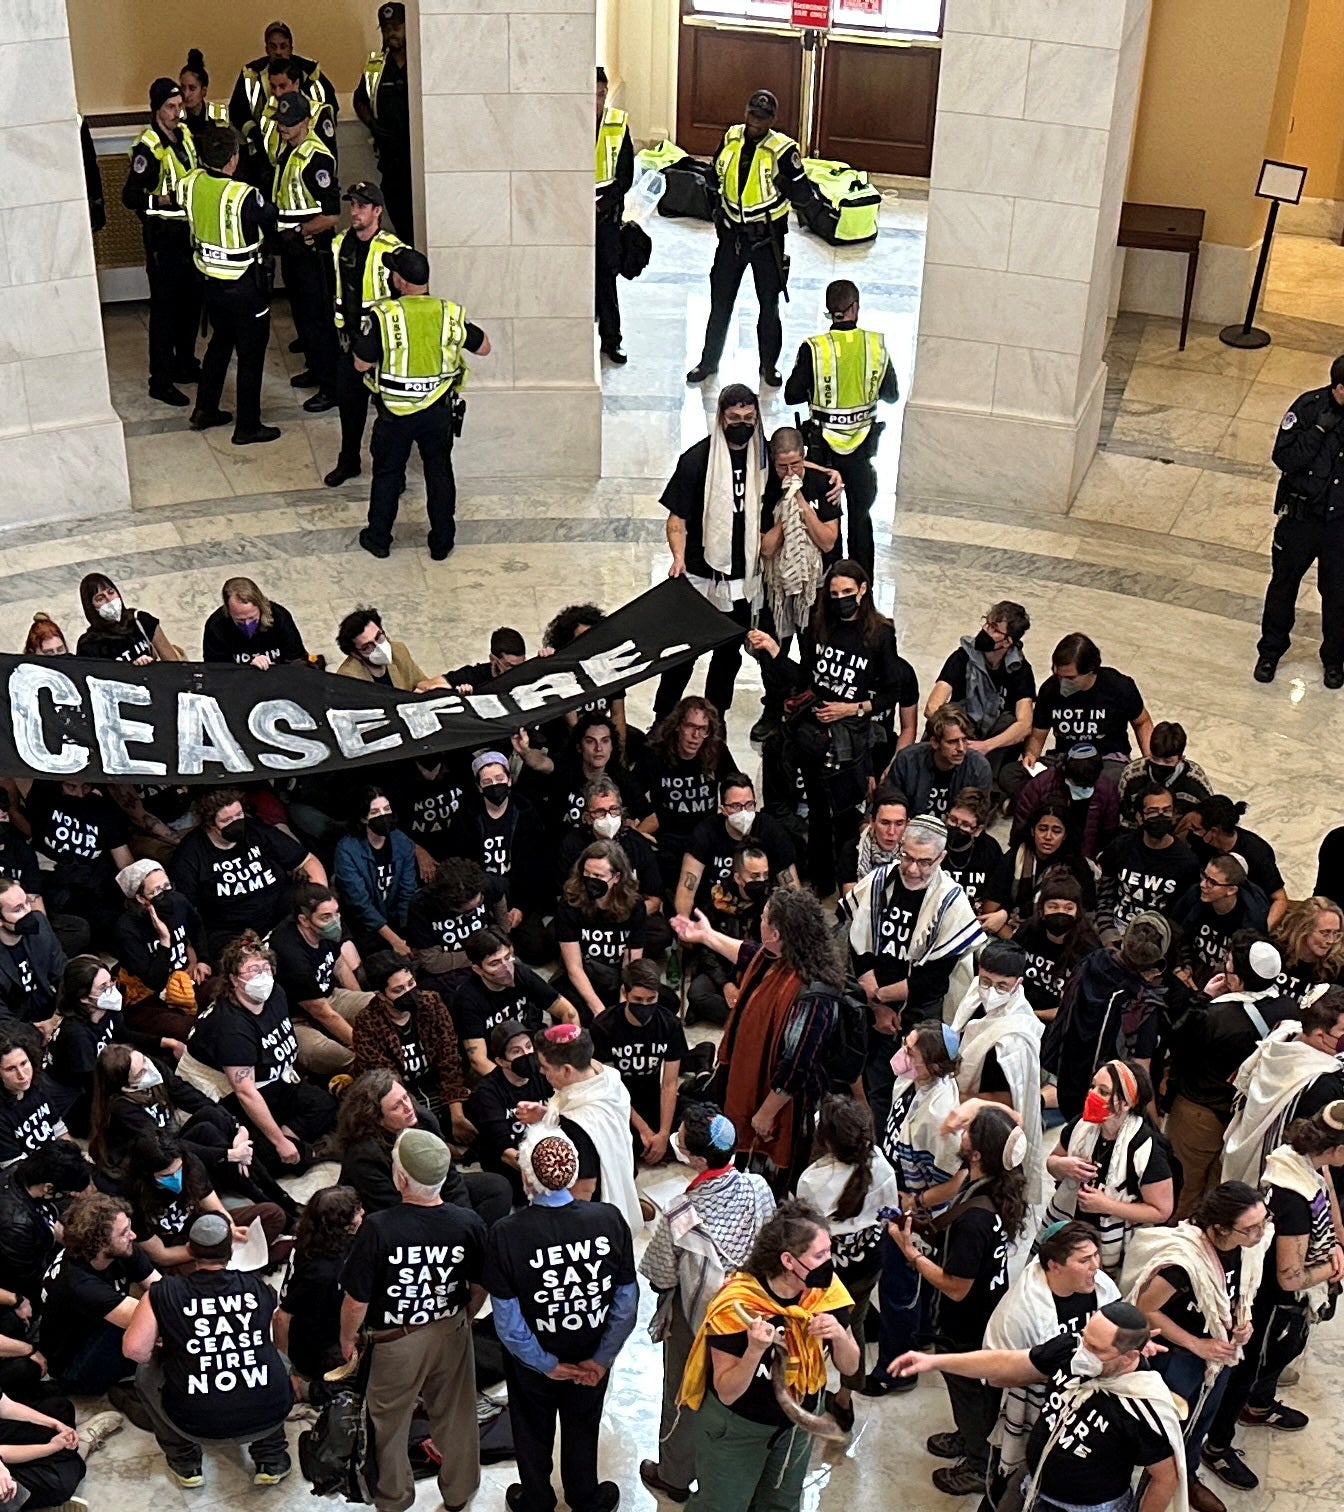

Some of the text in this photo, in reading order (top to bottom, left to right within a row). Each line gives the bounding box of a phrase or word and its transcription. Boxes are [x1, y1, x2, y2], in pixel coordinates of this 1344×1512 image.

[814, 643, 868, 671] NOT IN
[816, 659, 856, 684] OUR
[1052, 708, 1106, 721] NOT IN
[1058, 720, 1099, 734] OUR
[660, 776, 694, 790] NOT
[669, 786, 710, 801] OUR
[55, 827, 97, 849] OUR
[212, 856, 248, 874] NOT
[222, 861, 264, 884] OUR
[216, 871, 278, 897] NAME
[1118, 869, 1177, 893] JEWS
[581, 928, 613, 943] NOT
[611, 1043, 643, 1058] NOT
[388, 1245, 466, 1266] JEWS
[529, 1235, 611, 1268] JEWS
[398, 1265, 454, 1284] SAY
[542, 1259, 603, 1288] SAY
[386, 1281, 459, 1299] CEASE
[533, 1274, 613, 1303] CEASE
[182, 1291, 259, 1318] JEWS
[397, 1296, 450, 1312] FIRE
[548, 1294, 603, 1317] FIRE
[194, 1312, 252, 1338] SAY
[535, 1304, 611, 1333] NOW
[186, 1330, 264, 1354] CEASE
[199, 1348, 257, 1371] FIRE
[187, 1363, 269, 1395] NOW
[1087, 1409, 1109, 1433] IN
